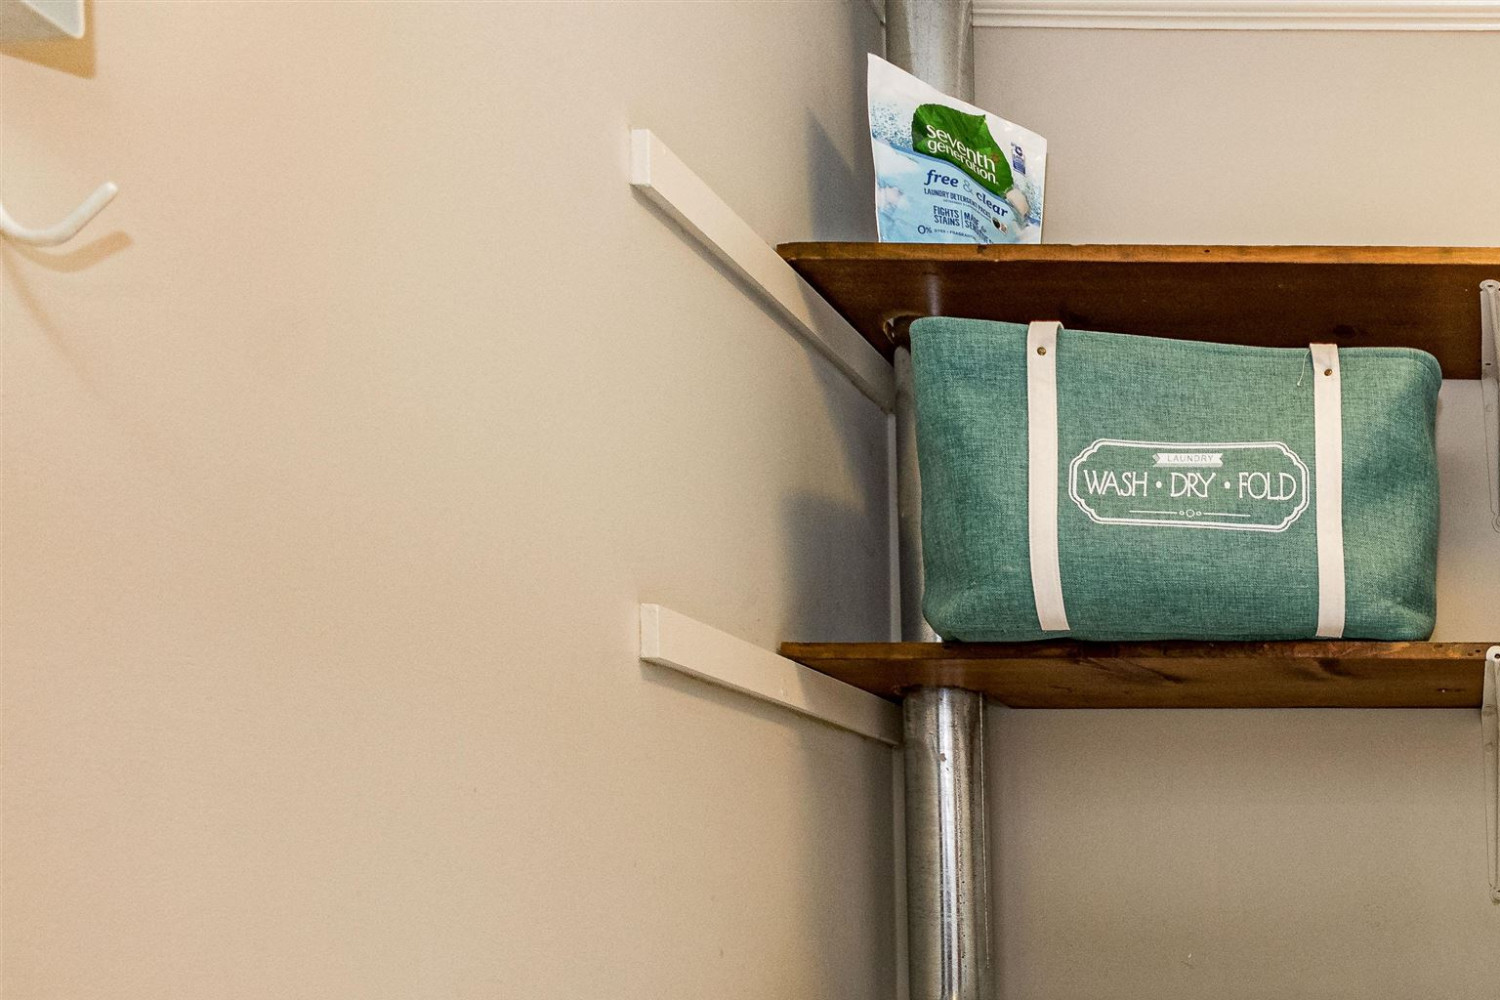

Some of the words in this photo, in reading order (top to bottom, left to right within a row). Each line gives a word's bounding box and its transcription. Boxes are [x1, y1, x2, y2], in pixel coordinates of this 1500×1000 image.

[927, 140, 996, 184] generation
[924, 187, 950, 198] LAUNDRY
[924, 169, 959, 187] free
[962, 180, 974, 195] &
[976, 192, 1008, 217] clear
[933, 205, 959, 219] FIGHTS
[934, 215, 960, 227] STAINS
[918, 225, 932, 235] 0%
[1167, 454, 1213, 462] LAUNDRY
[1083, 470, 1147, 497] WASH
[1170, 472, 1217, 498] DRY
[1239, 471, 1297, 500] FOLD
